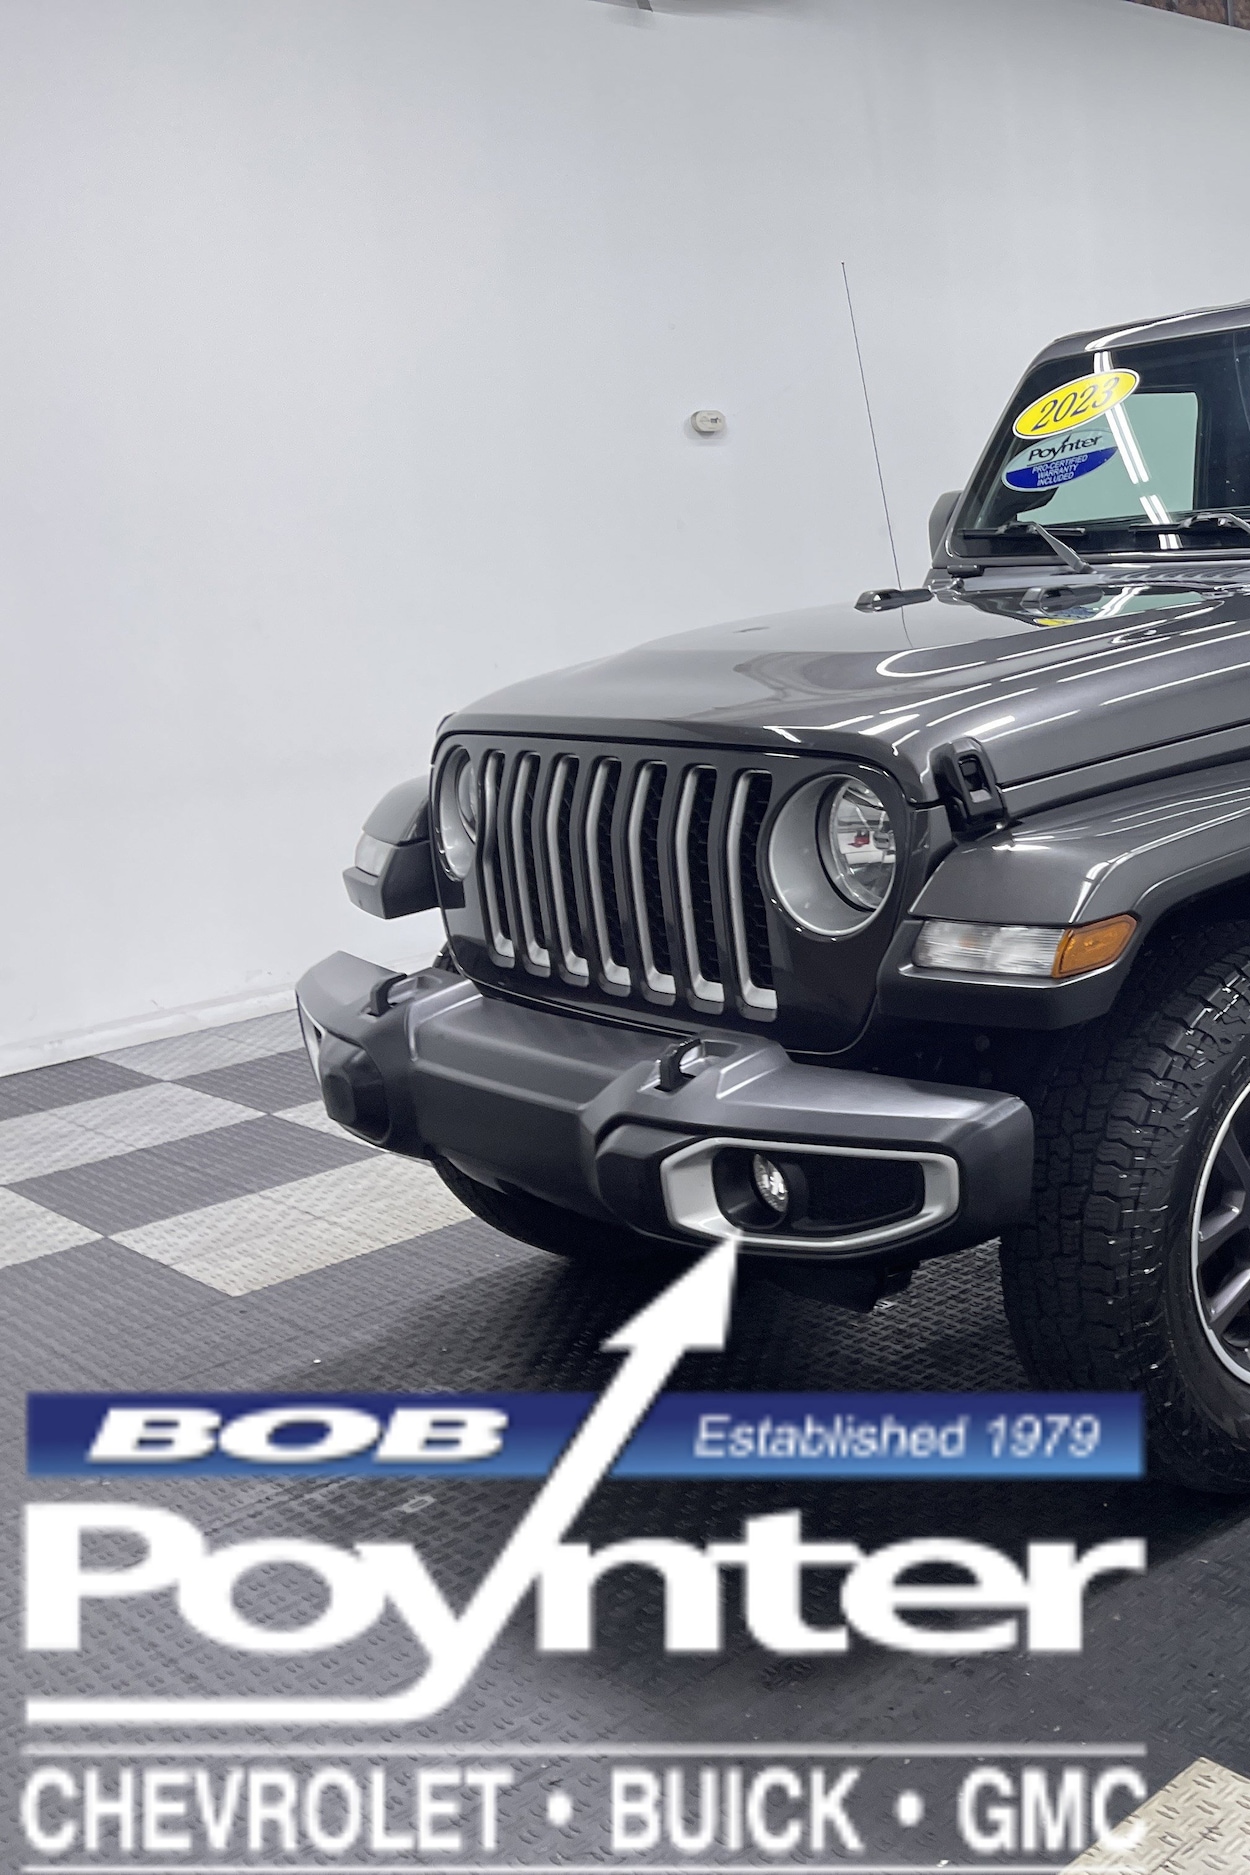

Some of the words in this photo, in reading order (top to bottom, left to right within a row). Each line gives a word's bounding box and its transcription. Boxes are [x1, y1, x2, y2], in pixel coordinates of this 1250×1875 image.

[1031, 377, 1120, 431] 2023
[1028, 434, 1102, 462] Poynter
[1031, 454, 1088, 475] PRO-CERTIFIED
[1037, 464, 1079, 480] WARRANTY
[1036, 472, 1074, 487] INCLUDED
